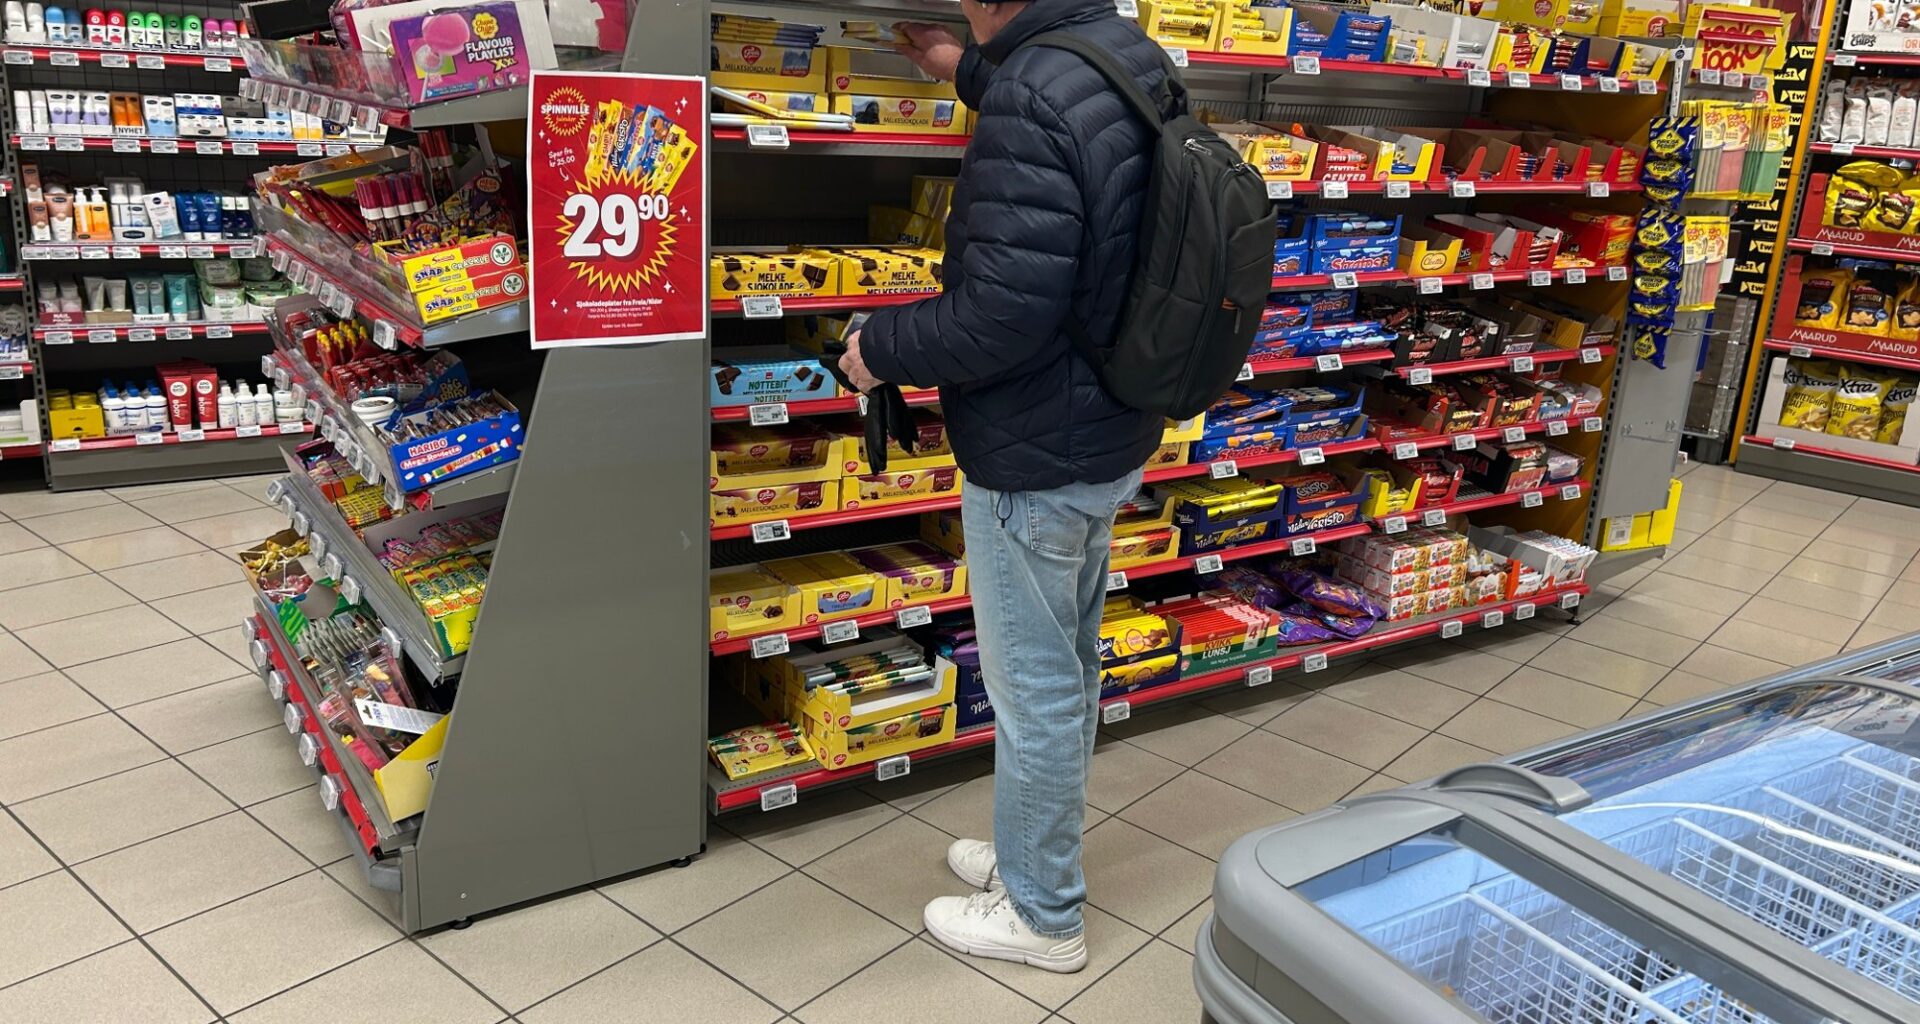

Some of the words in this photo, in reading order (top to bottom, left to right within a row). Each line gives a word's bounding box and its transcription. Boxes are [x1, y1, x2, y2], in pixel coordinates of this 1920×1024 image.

[1433, 2, 1454, 12] twist
[465, 36, 514, 53] FLAVOUR
[1850, 38, 1876, 47] CHIPS
[468, 46, 515, 63] PLAYLIST
[540, 104, 590, 115] SPINNVILLE
[118, 127, 143, 135] NYHET
[549, 150, 563, 160] Spar
[564, 148, 573, 157] fra
[557, 156, 575, 166] 25.00
[1323, 173, 1367, 182] CENTER
[563, 194, 640, 257] 29
[638, 194, 669, 220] 90
[1815, 228, 1865, 242] MAARUD
[414, 268, 443, 283] SNAP
[451, 254, 490, 271] CRACKLE
[1331, 257, 1384, 270] Stratos
[758, 272, 786, 283] MELKE
[892, 271, 916, 280] MELKE
[747, 282, 795, 291] SJOKOLADE
[867, 286, 938, 294] MELKESJOKOLADE
[425, 299, 454, 313] SNAP
[463, 285, 500, 301] CRACKLE
[1789, 329, 1837, 343] MAARUD
[1867, 339, 1918, 354] MAARUD
[748, 380, 788, 390] NØTTEBIT
[1840, 378, 1878, 394] Xtra
[1834, 401, 1872, 415] POTETCHIPS
[409, 438, 448, 456] HARIBO
[740, 503, 790, 513] MELKESJOKOLADE
[1288, 520, 1310, 534] Nidar
[1309, 511, 1345, 530] CRISPO
[1248, 627, 1258, 640] 4
[1204, 637, 1233, 650] KVIKK
[1202, 647, 1231, 660] LUNSJ
